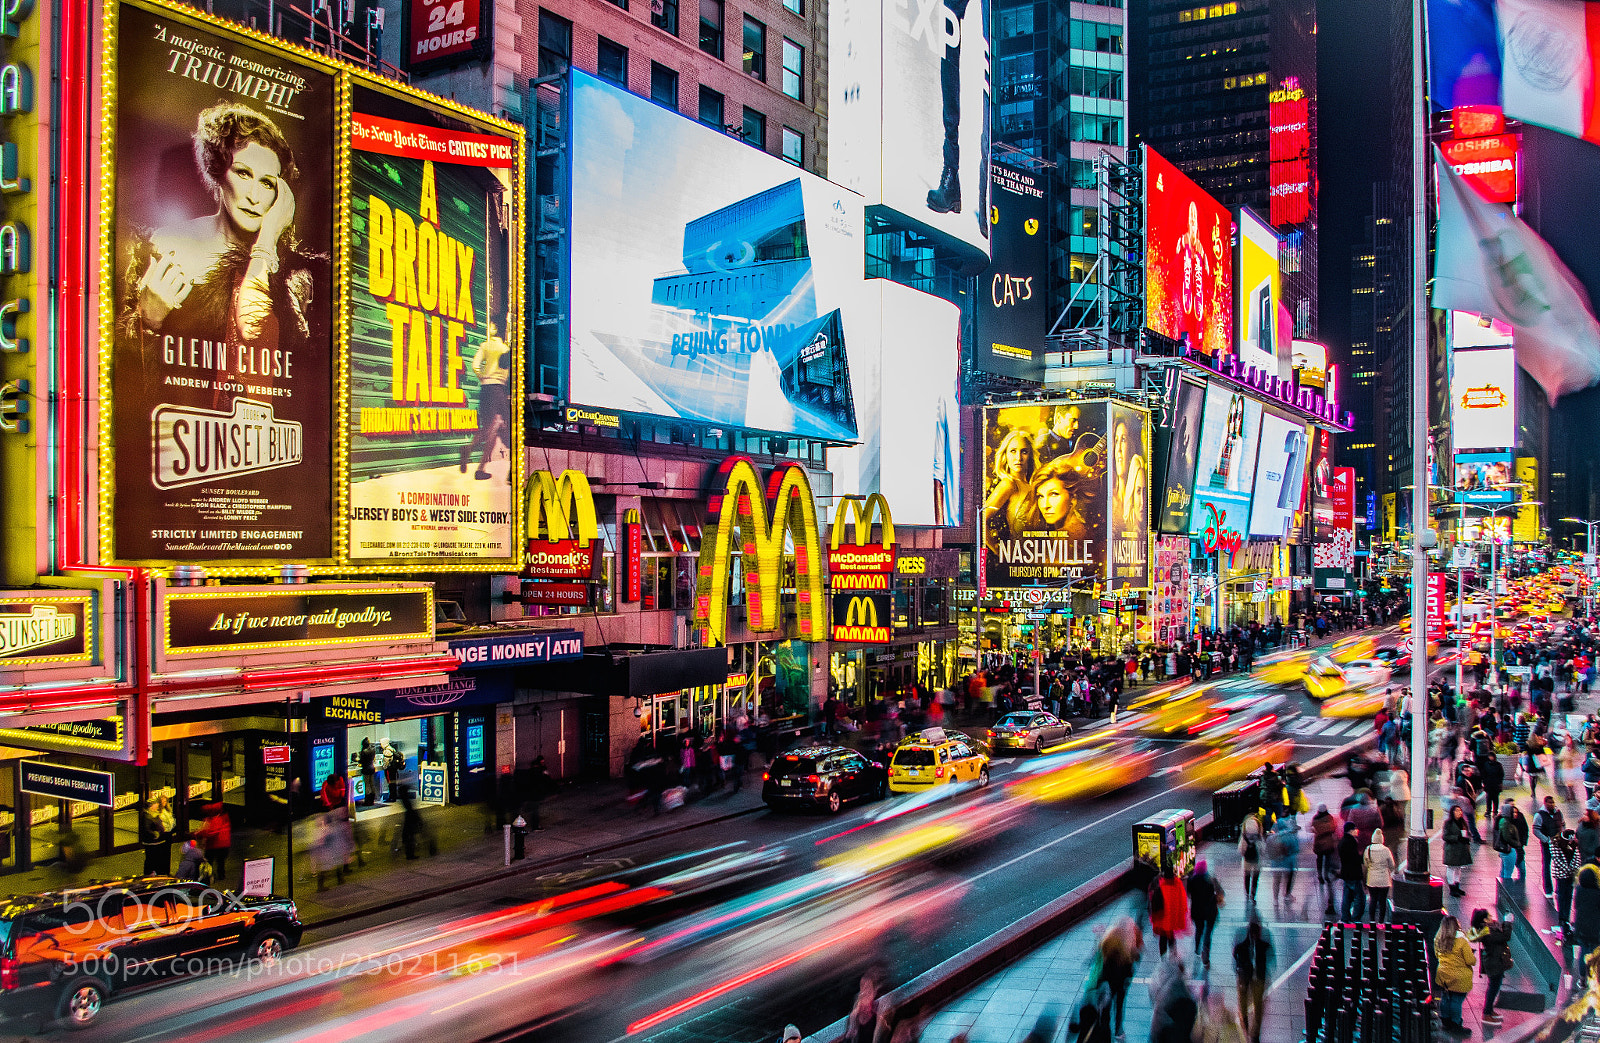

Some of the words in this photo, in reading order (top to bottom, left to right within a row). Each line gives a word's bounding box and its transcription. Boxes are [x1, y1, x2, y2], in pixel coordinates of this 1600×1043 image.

[428, 1, 465, 33] 24
[417, 26, 477, 55] HOURS
[170, 34, 226, 63] majestic,
[229, 54, 307, 92] mesmerizing,
[167, 49, 300, 109] TRIUMPH!”
[352, 121, 370, 139] The
[371, 125, 393, 142] New
[394, 130, 418, 148] York
[418, 133, 447, 153] Times
[448, 139, 489, 159] CRITICS'
[490, 144, 512, 160] PICK
[1448, 137, 1508, 153] OSHIBA
[1449, 158, 1513, 176] OSHIBA
[1003, 168, 1020, 181] BACK
[1020, 175, 1034, 186] AND
[1006, 179, 1024, 193] THAN
[420, 160, 439, 226] A
[369, 194, 476, 326] BRONX
[991, 272, 1033, 308] CATS
[670, 328, 728, 361] BEIJING
[737, 323, 795, 354] TOWN
[164, 334, 227, 371] GLENN
[238, 344, 293, 379] CLOSE
[386, 303, 465, 405] TALE
[164, 375, 209, 389] ANDREW
[213, 381, 244, 393] LLOYD
[247, 384, 292, 398] WEBBER'S
[1264, 378, 1339, 424] BROADWAY
[360, 407, 419, 433] BROADWAY'S
[419, 408, 438, 431] NEW
[451, 409, 479, 430] MUSICAL
[172, 418, 262, 477] SUNSET
[269, 426, 300, 463] BLVD.
[201, 487, 224, 495] SUNSET
[225, 488, 260, 496] BOULEVARD
[407, 492, 460, 507] COMBINATION
[461, 494, 471, 507] OF
[350, 507, 389, 521] JERSEY
[391, 508, 418, 522] BOYS
[420, 509, 427, 521] &
[430, 509, 455, 522] WEST
[457, 510, 477, 523] SIDE
[151, 529, 197, 539] STRICTLY
[201, 530, 238, 540] LIMITED
[240, 530, 304, 540] ENGAGEMENT
[165, 542, 274, 551] SunsetBoulevardTheMusical.com
[999, 539, 1093, 564] NASHVILLE
[1112, 540, 1147, 564] NASHVILLE
[523, 552, 590, 565] McDonald's
[830, 552, 891, 564] McDonald's
[897, 556, 926, 574] RESS
[530, 566, 577, 575] Restaurant
[1009, 566, 1042, 578] THURSDAYS
[522, 590, 543, 598] OPEN
[556, 591, 584, 599] HOURS
[953, 589, 993, 601] GIFS
[1003, 590, 1072, 602] LUGAGE
[1427, 575, 1438, 616] LOVE
[210, 613, 231, 631] As
[232, 611, 248, 635] if
[248, 615, 268, 629] we
[270, 614, 308, 627] never
[308, 608, 339, 625] said
[338, 606, 392, 628] goodbye.
[0, 619, 50, 649] SUNSET
[54, 618, 74, 638] BLVD.
[492, 642, 543, 661] MONEY
[552, 638, 581, 656] ATM
[876, 653, 896, 663] EXPRESS
[332, 696, 370, 710] MONEY
[325, 706, 382, 723] EXCHANGE
[468, 716, 485, 724] CHANGE
[72, 722, 103, 738] goodbye.
[313, 737, 335, 745] CHANGE
[28, 772, 54, 786] PREVIEWS
[54, 777, 71, 788] BEGIN
[71, 778, 99, 793] FEBRUARY
[99, 785, 104, 793] 2
